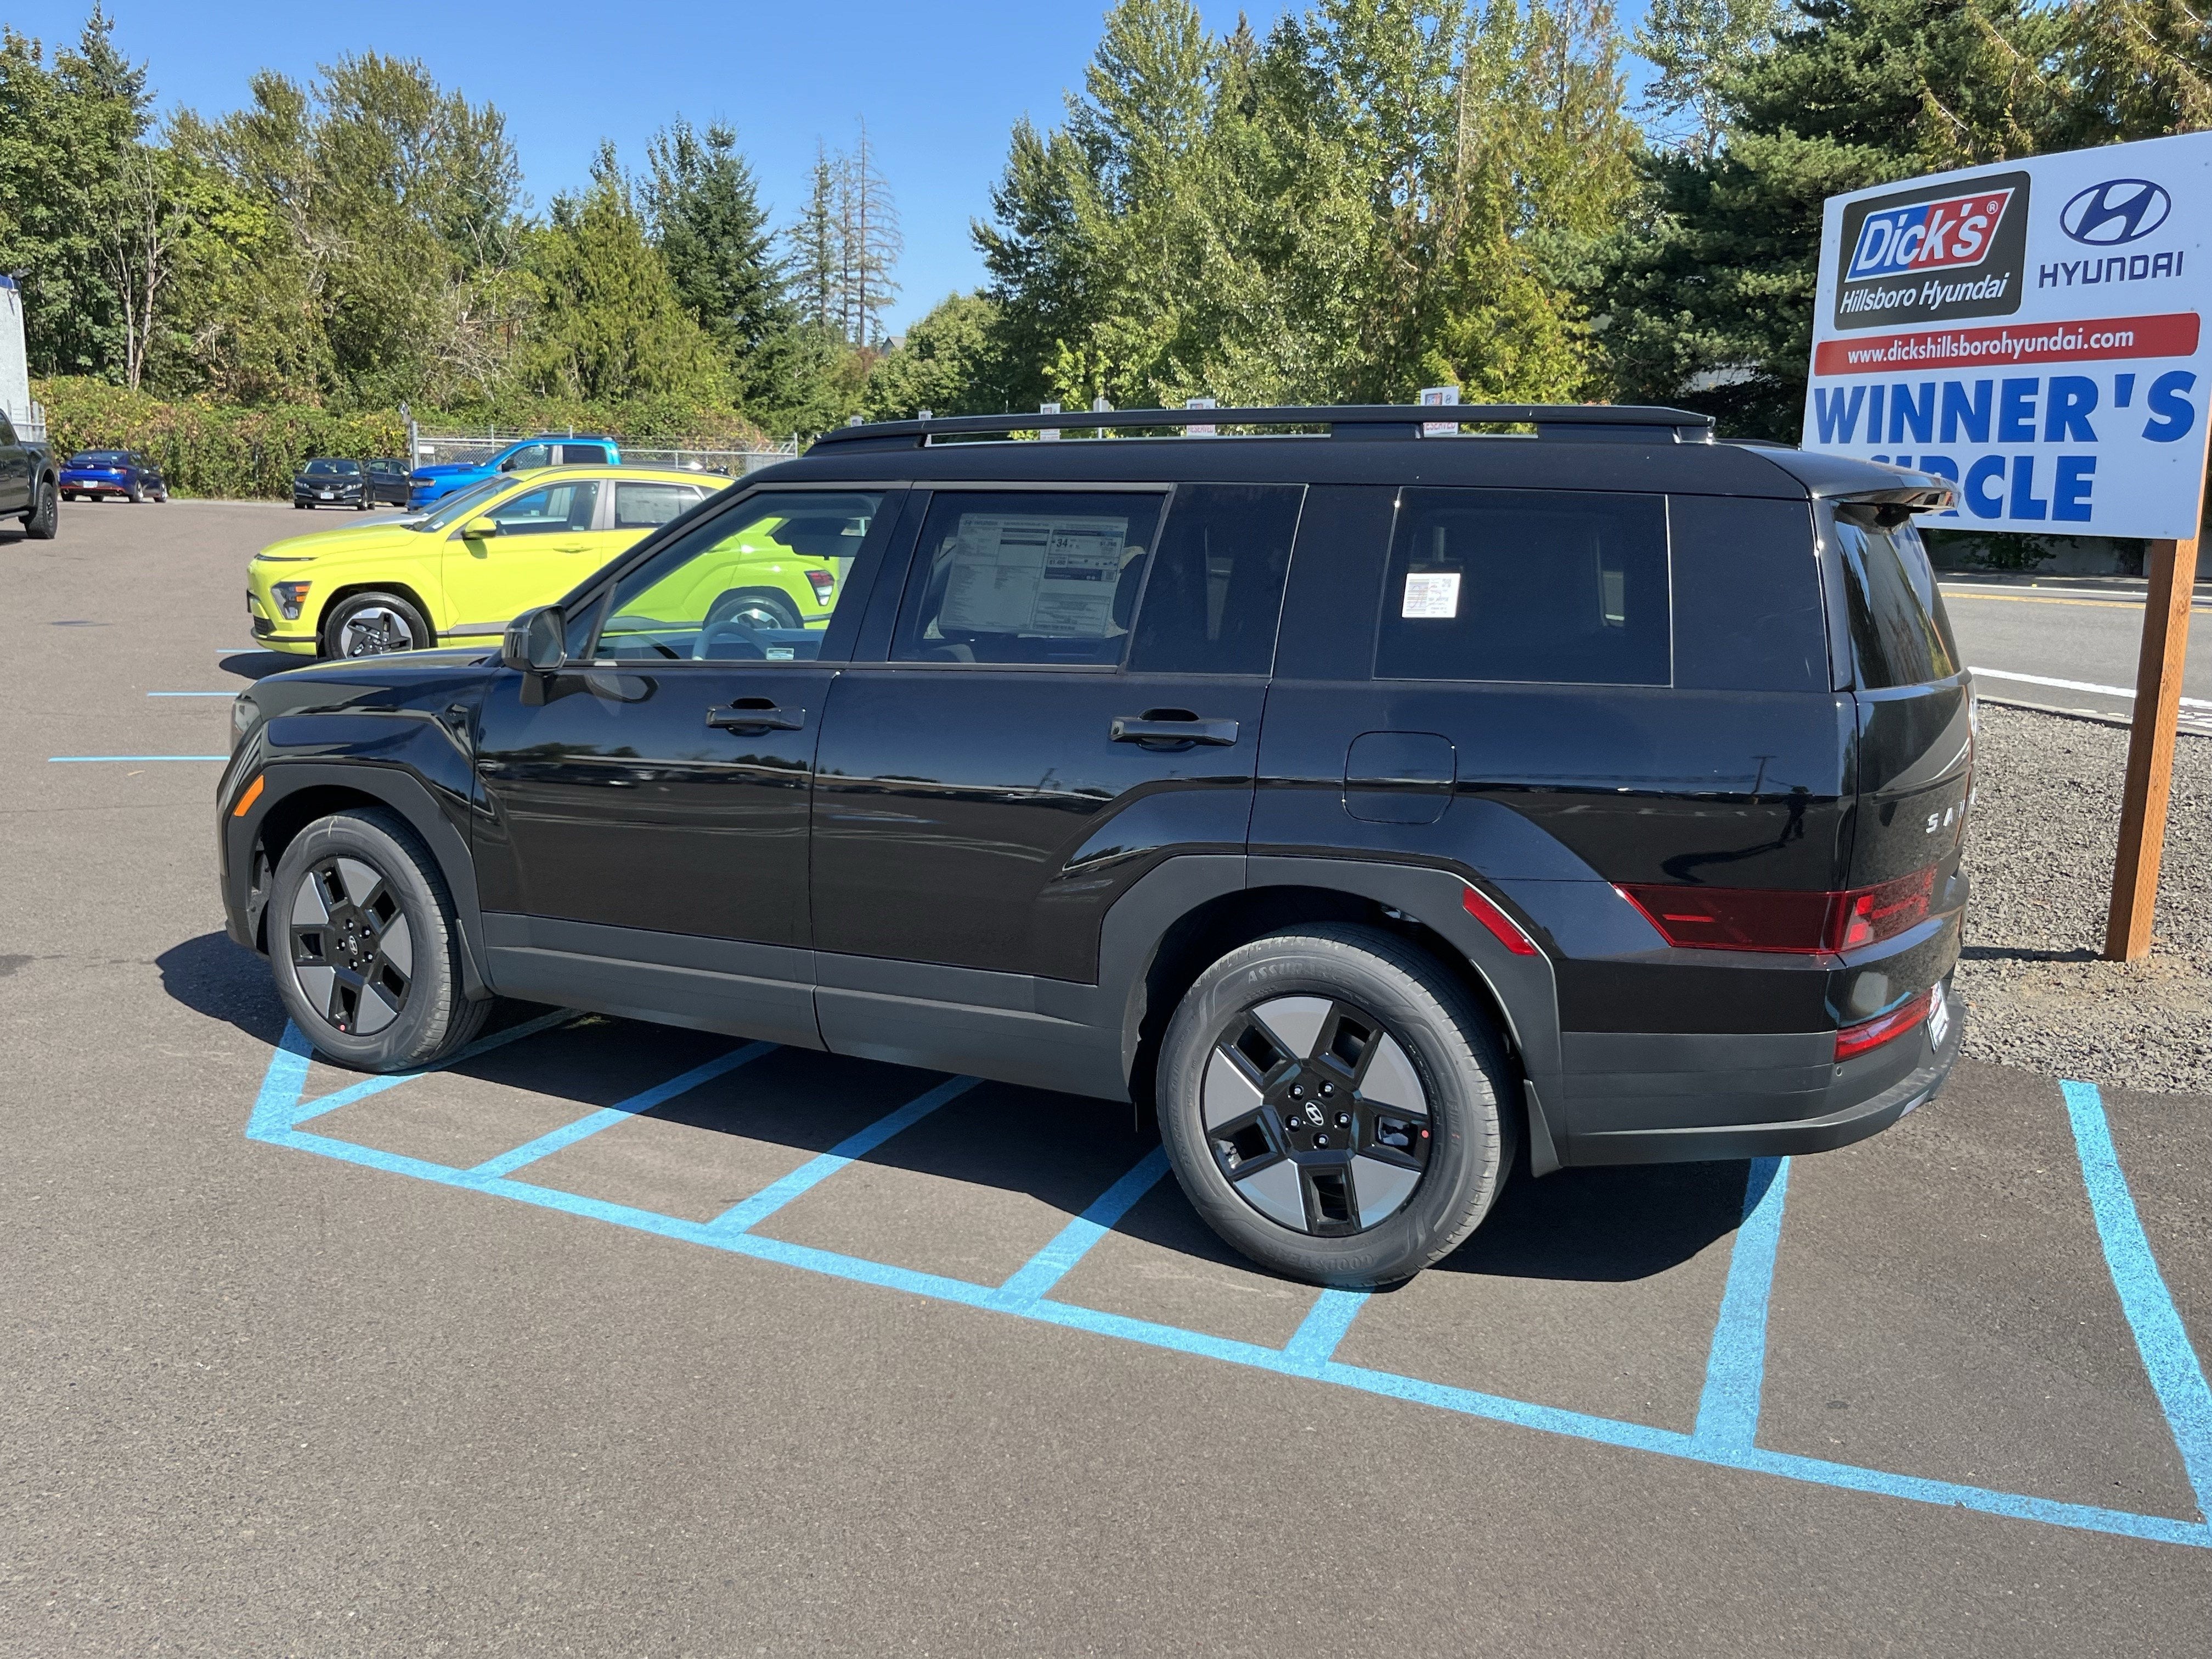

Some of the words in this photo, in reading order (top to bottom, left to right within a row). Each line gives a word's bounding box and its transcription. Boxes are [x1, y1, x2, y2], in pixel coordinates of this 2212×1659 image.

[2039, 251, 2184, 289] HYUNDAI
[1839, 286, 1916, 314] Hillsboro
[1918, 272, 2011, 311] Hyundai
[1847, 327, 2134, 364] www.dickshillsborohyundai.com
[1814, 370, 2198, 444] WINNER'S
[1870, 454, 2097, 522] CLE
[1056, 538, 1068, 548] 34
